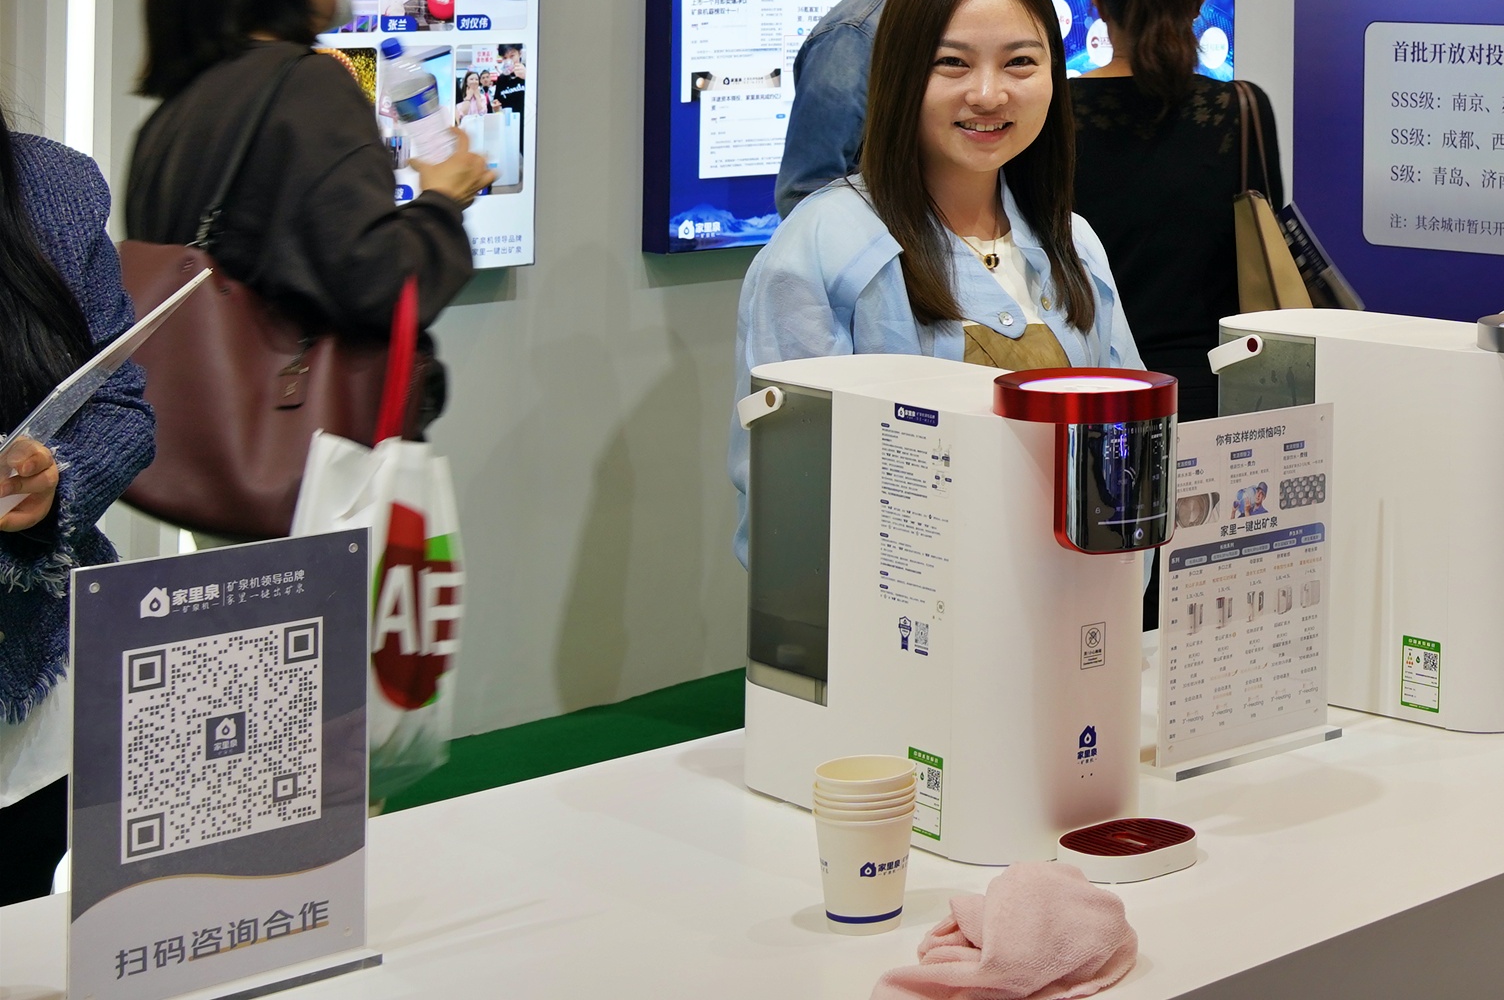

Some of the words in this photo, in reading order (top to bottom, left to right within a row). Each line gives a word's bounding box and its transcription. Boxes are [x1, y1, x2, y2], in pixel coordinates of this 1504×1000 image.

[387, 19, 407, 31] 张兰
[460, 17, 488, 29] 刘仪伟
[1215, 425, 1286, 446] 你有这样的烦恼吗？
[1220, 516, 1278, 537] 家里一键出矿泉
[172, 584, 220, 606] 家里泉
[226, 569, 305, 592] 矿泉机领导品牌
[115, 900, 330, 980] 扫码咨询合作
